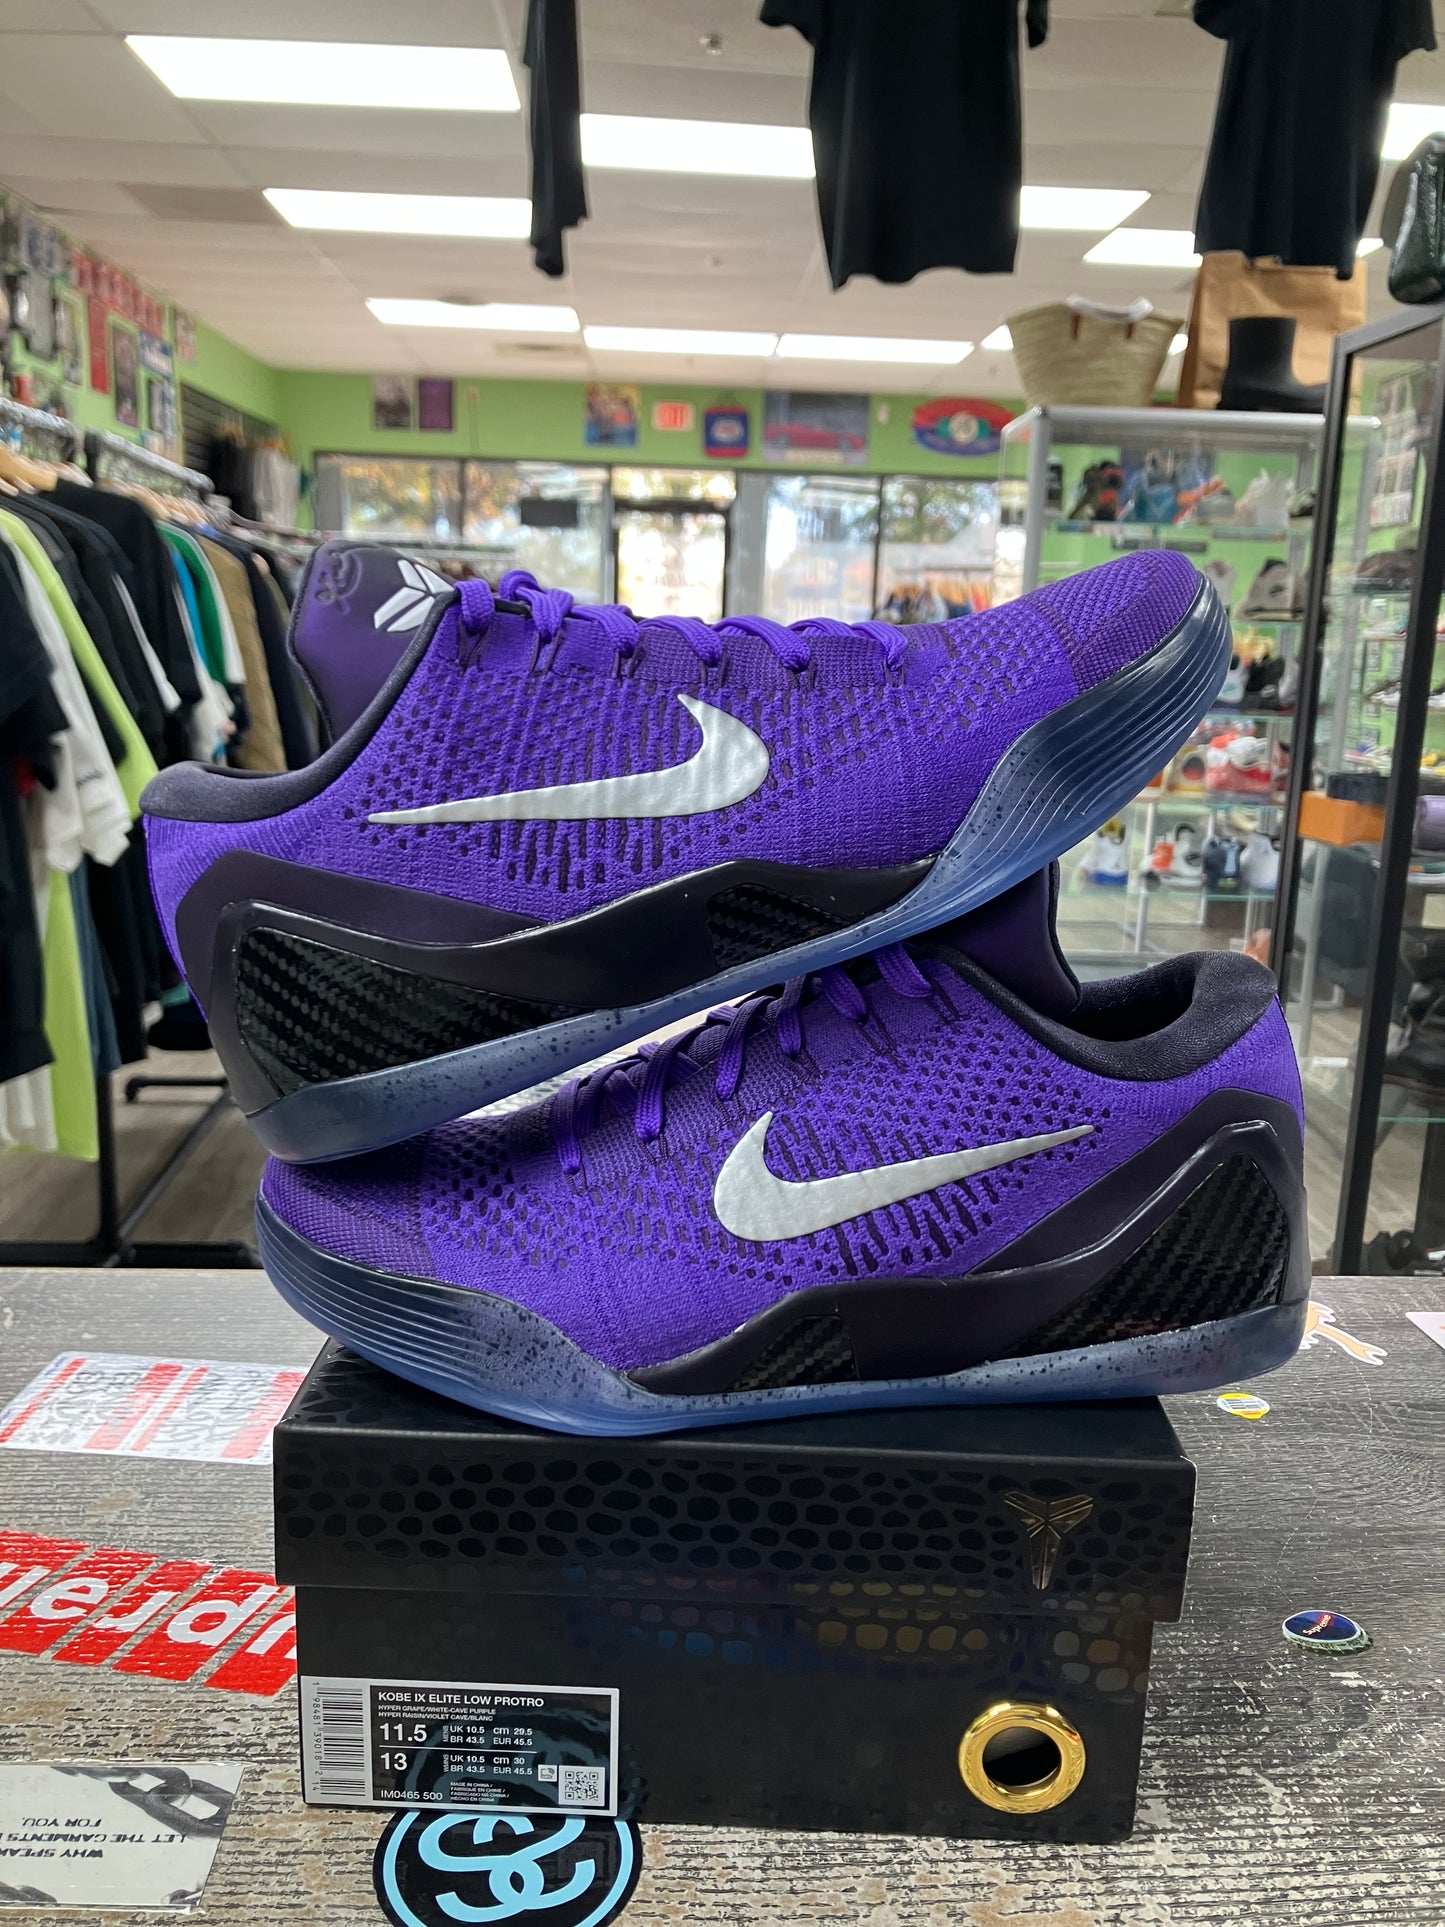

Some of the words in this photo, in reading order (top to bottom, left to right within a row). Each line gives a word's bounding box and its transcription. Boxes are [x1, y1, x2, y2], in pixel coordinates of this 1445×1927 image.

[378, 1692, 411, 1702] KOBE
[414, 1693, 426, 1703] IX
[429, 1694, 461, 1704] ELITE
[464, 1695, 491, 1705] LOW
[494, 1696, 544, 1707] PROTRO
[312, 1697, 321, 1725] 98481
[402, 1705, 468, 1714] GRAPE/WHITE-CAVE
[379, 1723, 427, 1742] 11.5
[466, 1726, 485, 1734] 10.5
[513, 1728, 533, 1736] 29.5
[466, 1736, 485, 1744] 43.5
[493, 1737, 511, 1745] EUR
[513, 1738, 533, 1746] 45.5
[313, 1732, 322, 1761] 39018
[380, 1752, 408, 1771] 13
[466, 1755, 485, 1763] 10.5
[513, 1757, 525, 1765] 30
[466, 1765, 485, 1773] 43.5
[513, 1767, 533, 1775] 45.5
[311, 1782, 320, 1791] 14
[381, 1790, 420, 1800] IM0465
[423, 1791, 443, 1801] 500
[22, 1817, 59, 1827] YOU.
[65, 1818, 102, 1827] FOR
[7, 1833, 107, 1842] GARMENTS
[110, 1833, 145, 1843] THE
[151, 1833, 187, 1843] LET
[60, 1848, 104, 1858] WHY
